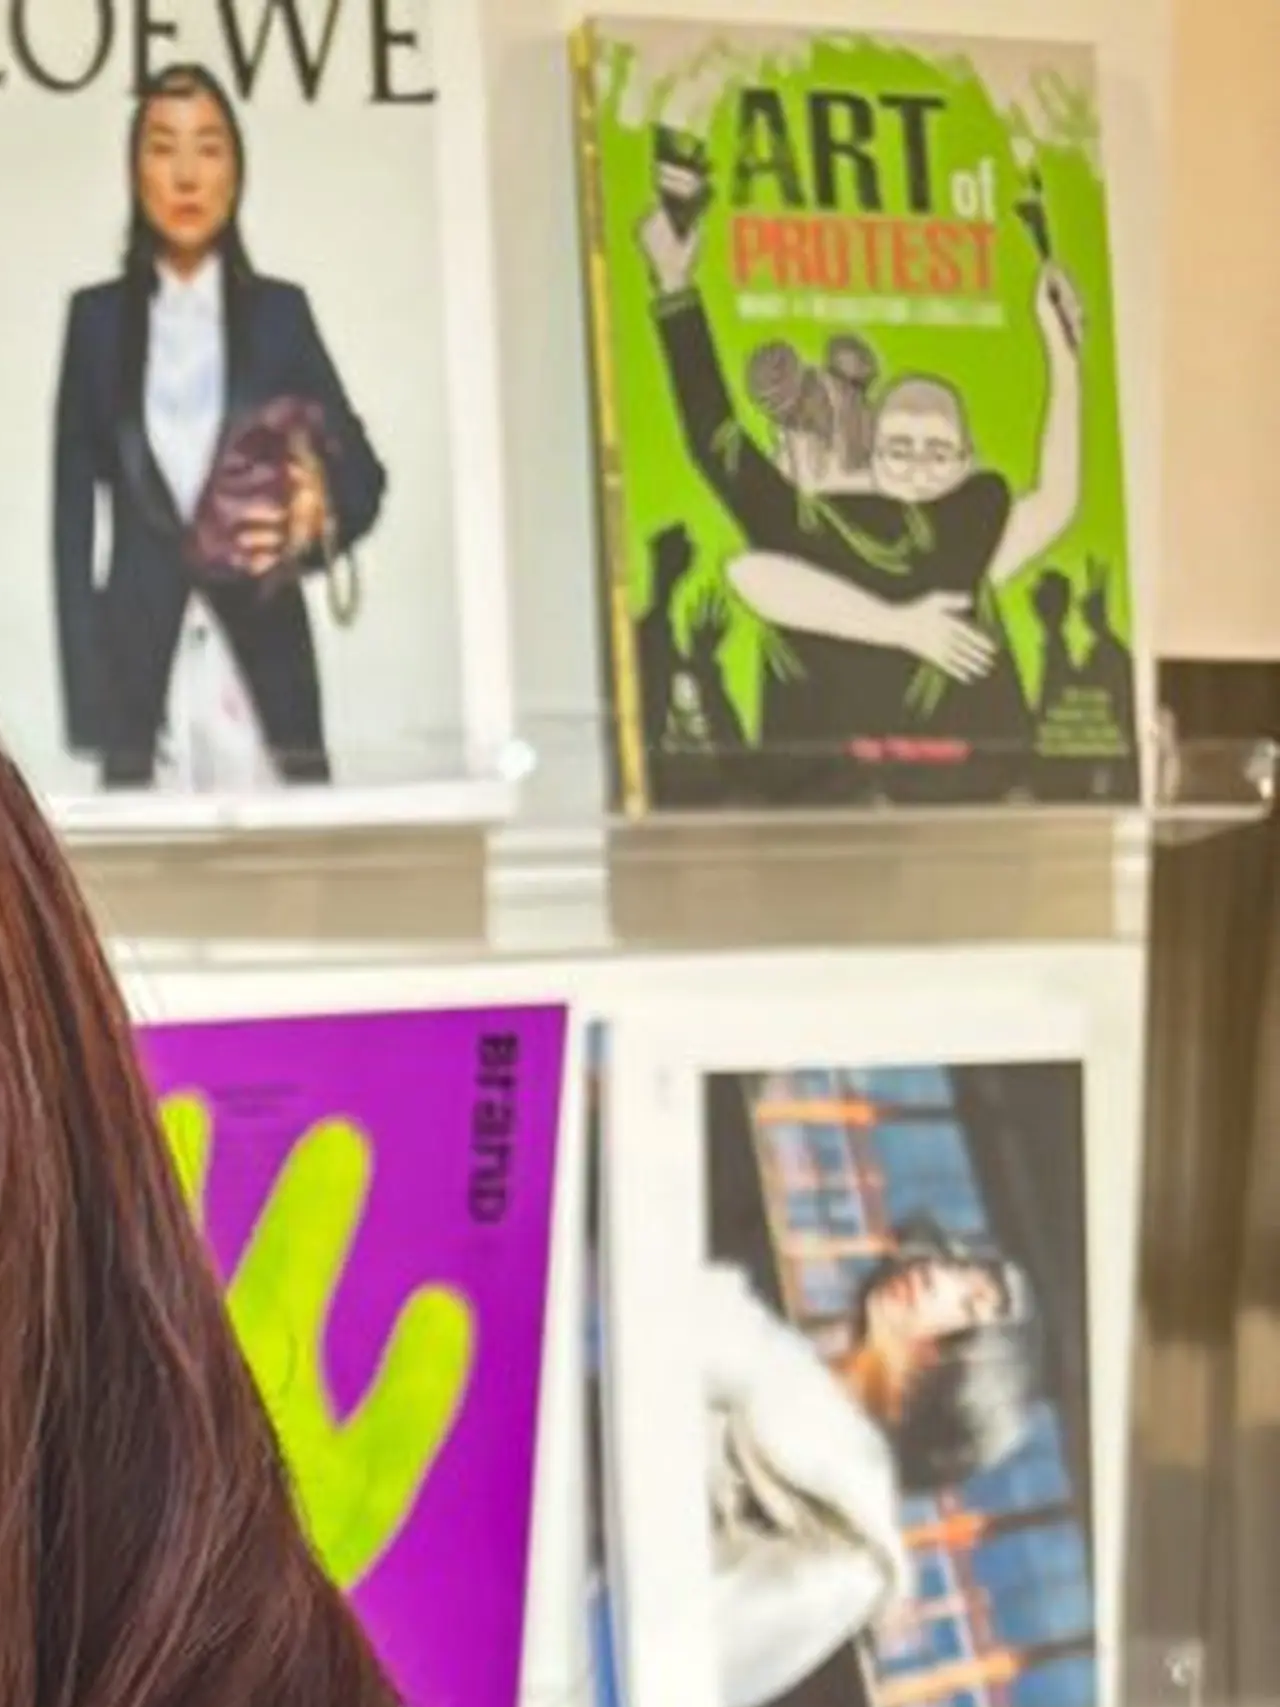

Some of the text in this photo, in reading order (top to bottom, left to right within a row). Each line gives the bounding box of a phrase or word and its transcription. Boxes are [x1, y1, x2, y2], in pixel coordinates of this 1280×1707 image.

[731, 89, 998, 224] ART of
[731, 213, 998, 293] PROTEST
